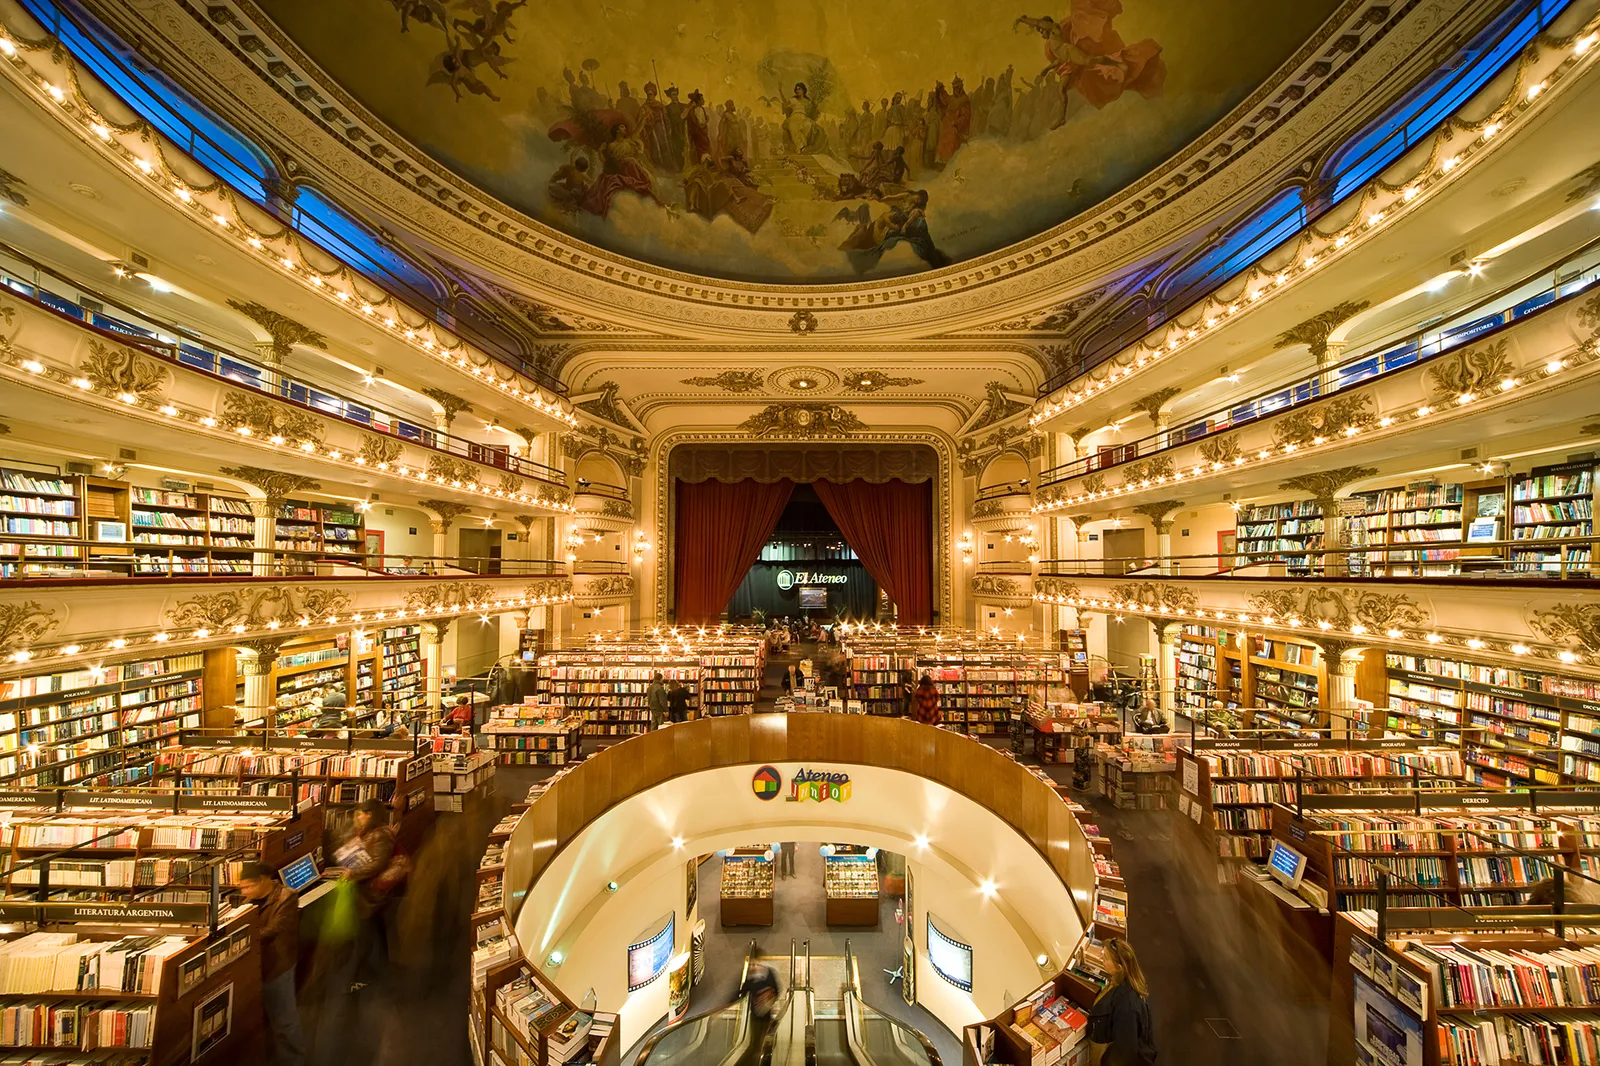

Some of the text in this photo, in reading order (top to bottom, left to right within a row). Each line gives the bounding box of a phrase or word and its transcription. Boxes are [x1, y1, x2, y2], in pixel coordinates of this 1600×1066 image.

[794, 572, 848, 584] El Ateneo
[1490, 688, 1524, 698] DICCIONARIOS
[793, 767, 849, 782] Ateneo
[100, 797, 153, 805] LATINOAMERICANA
[74, 908, 174, 917] LITERATURA ARGENTINA
